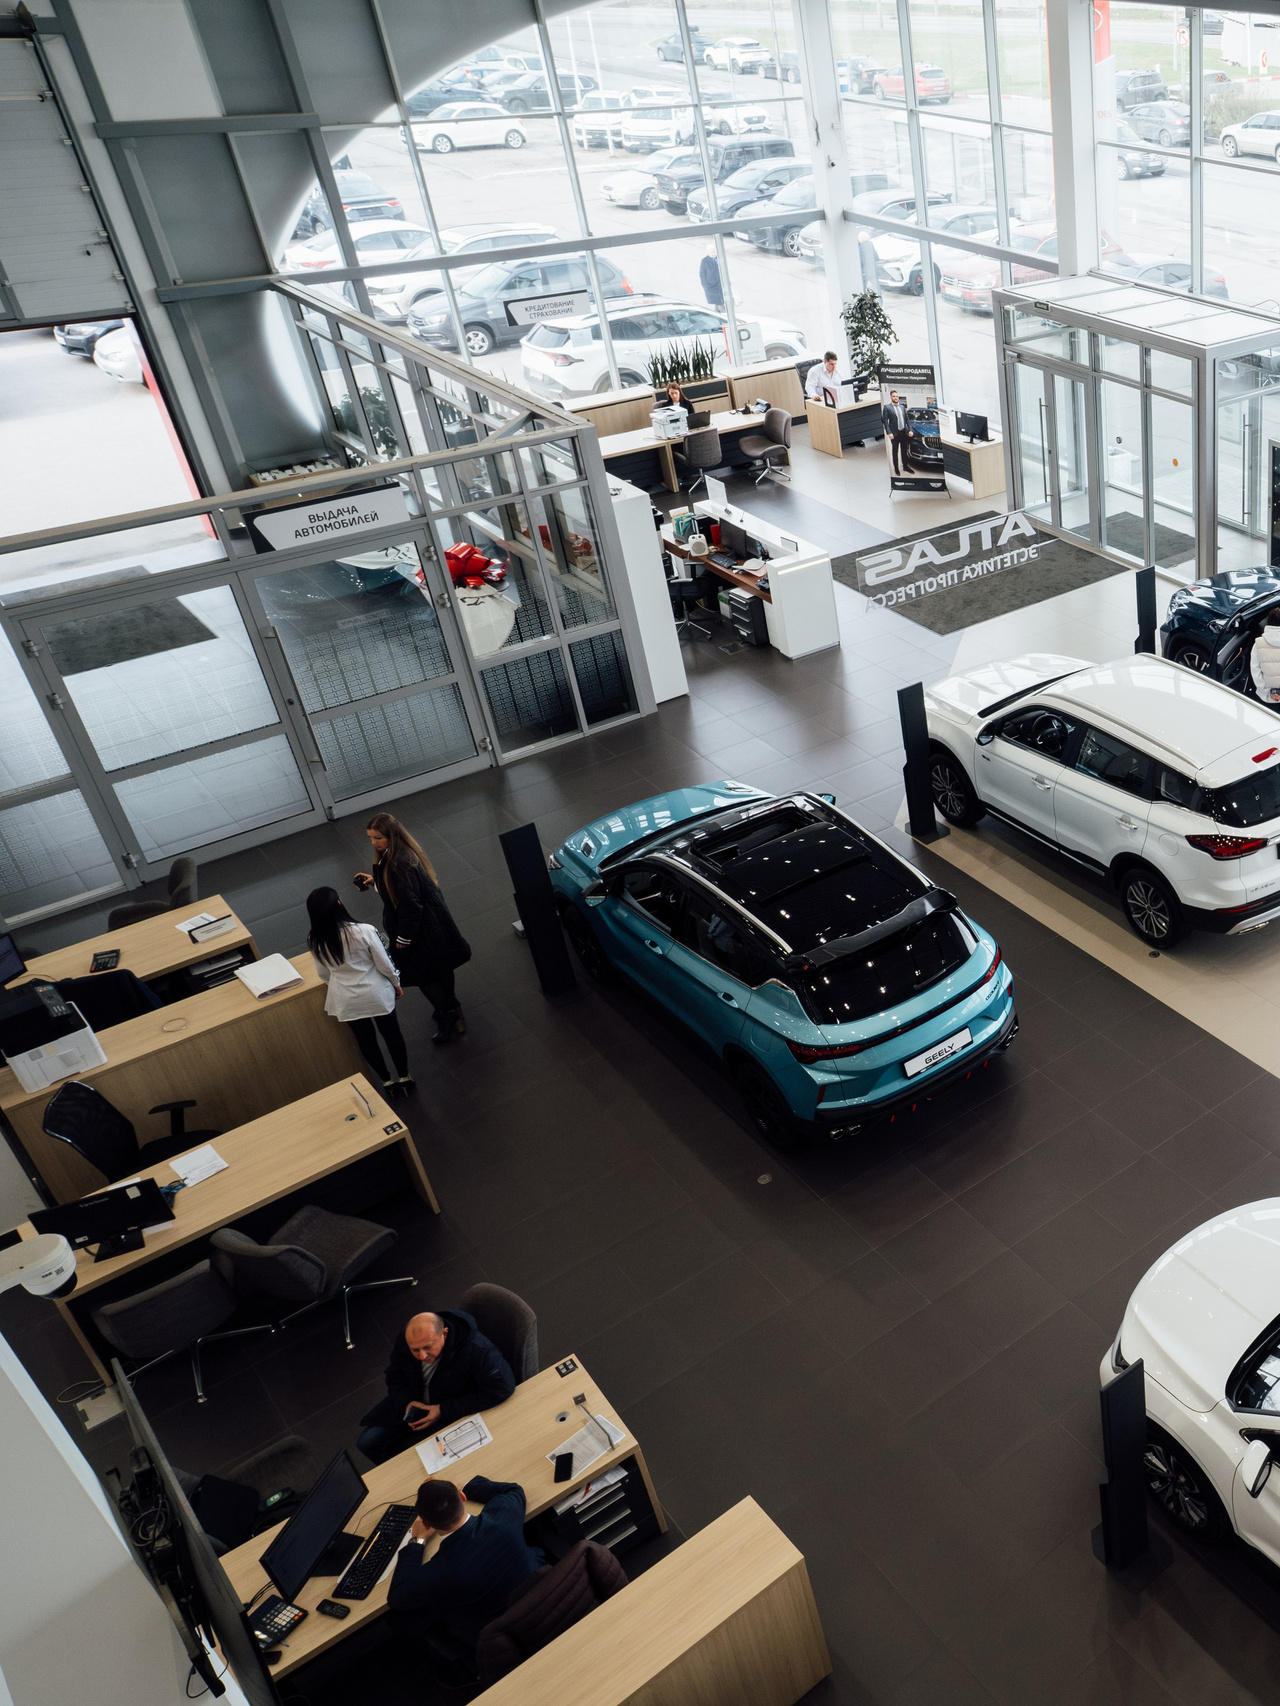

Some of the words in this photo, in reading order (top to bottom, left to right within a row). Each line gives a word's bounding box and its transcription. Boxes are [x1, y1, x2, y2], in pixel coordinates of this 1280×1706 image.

[524, 299, 575, 313] КРЕДИТОВАНИЕ
[529, 307, 574, 319] СТРАХОВАНИЕ
[307, 505, 359, 524] ВЫДАЧА
[294, 510, 380, 539] АВТОМОБИЛЕЙ
[924, 1042, 955, 1065] GEELY
